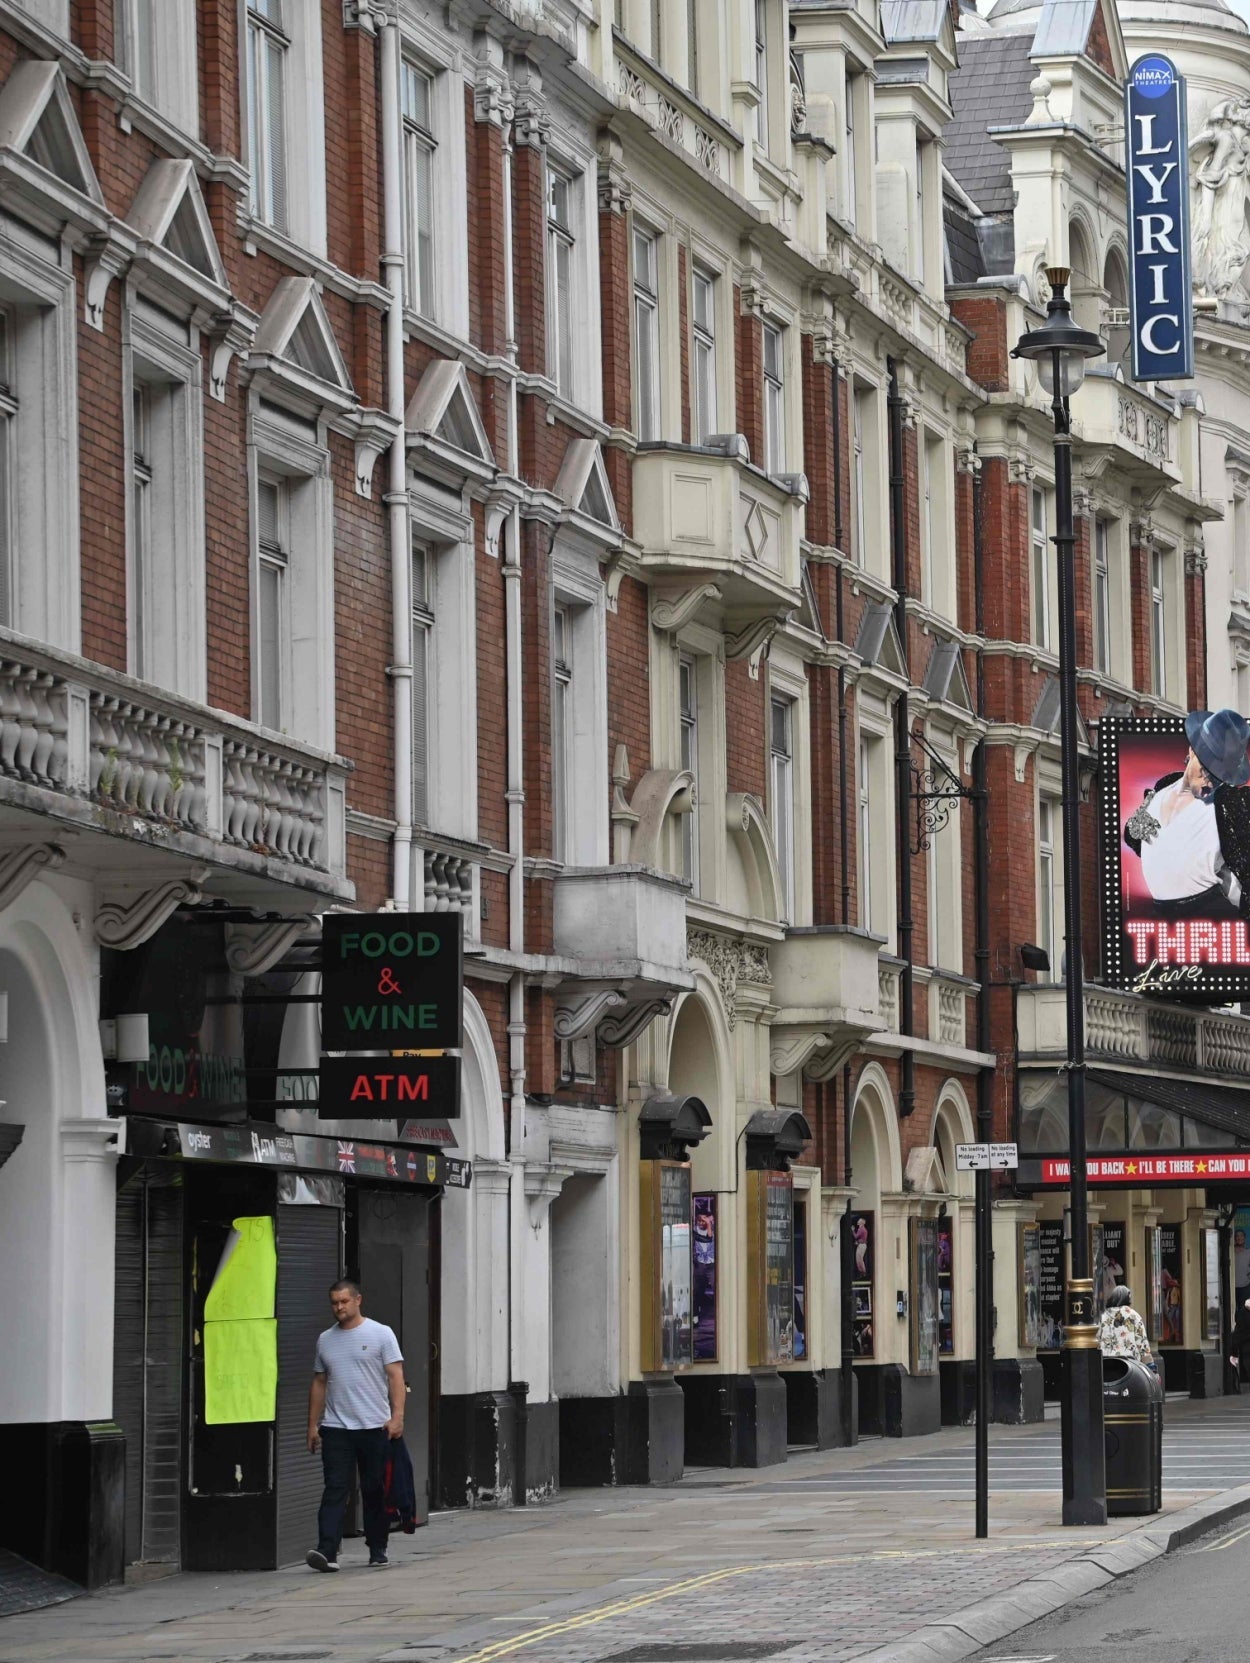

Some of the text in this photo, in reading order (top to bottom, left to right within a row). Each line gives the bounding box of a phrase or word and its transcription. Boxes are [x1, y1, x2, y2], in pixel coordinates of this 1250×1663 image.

[1135, 68, 1171, 80] NIMAX
[1134, 115, 1181, 356] LYRIC
[340, 931, 441, 959] FOOD
[377, 968, 402, 995] &
[1132, 958, 1203, 993] Live
[343, 1004, 438, 1030] WINE
[351, 1074, 429, 1100] ATM
[188, 1131, 212, 1152] oyster
[260, 1138, 275, 1158] ATM
[1050, 1163, 1053, 1176] I
[1102, 1160, 1124, 1175] BACK
[1139, 1160, 1153, 1174] I'LL
[1156, 1160, 1166, 1174] BE
[1169, 1159, 1194, 1174] THERE
[1208, 1159, 1226, 1173] CAN
[1228, 1159, 1245, 1172] YOU
